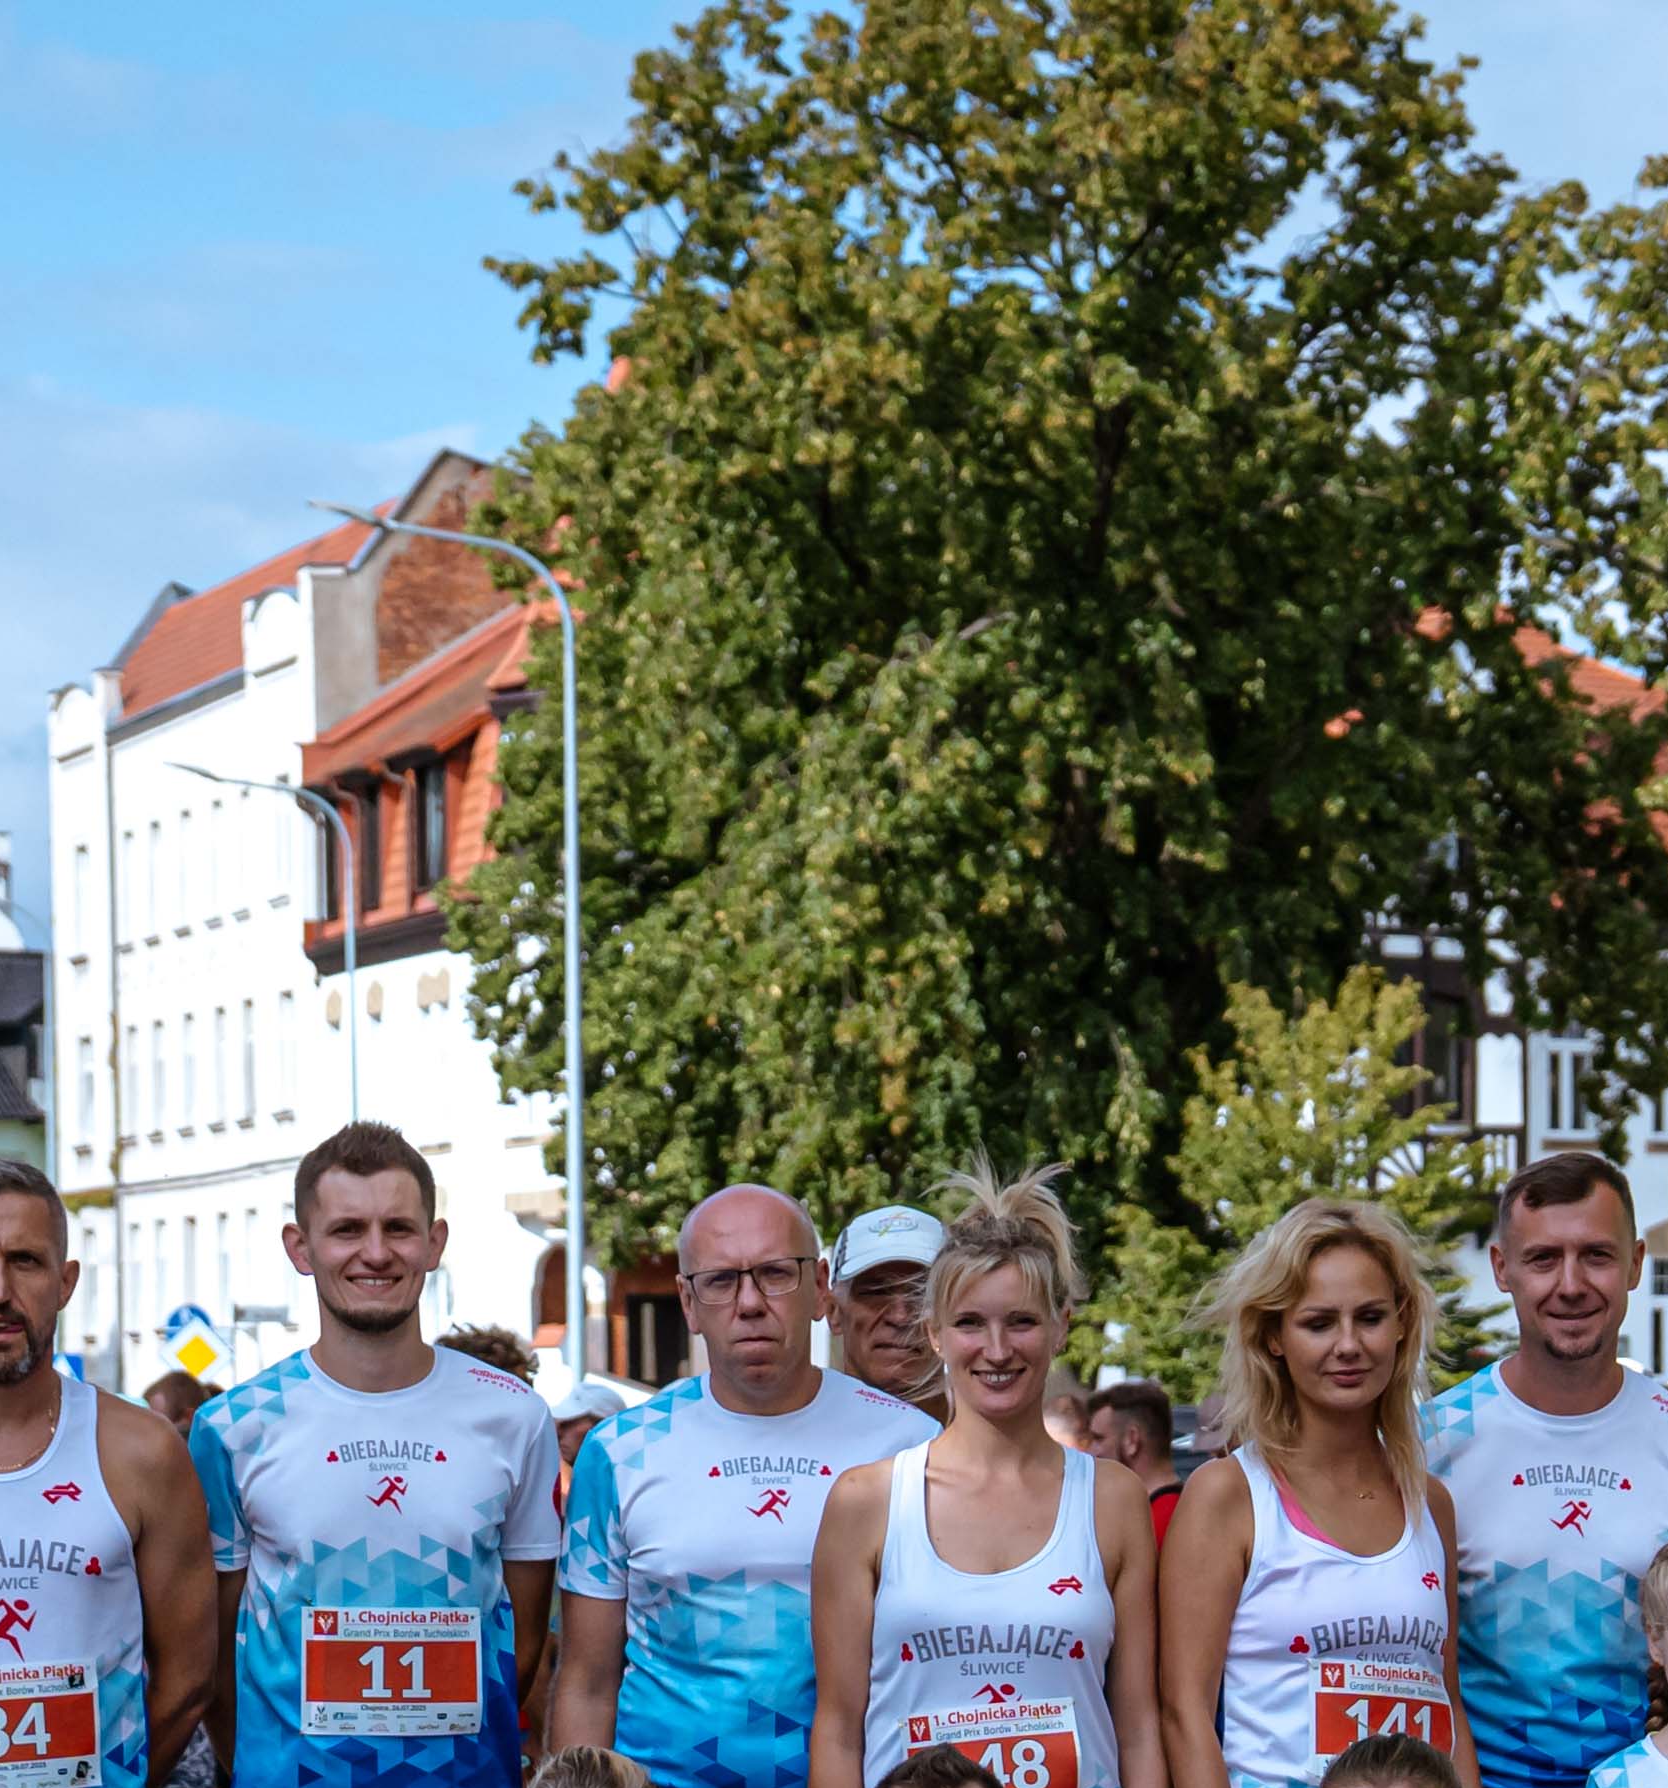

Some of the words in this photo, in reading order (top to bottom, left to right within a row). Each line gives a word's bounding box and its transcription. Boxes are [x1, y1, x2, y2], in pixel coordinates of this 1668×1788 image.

[339, 1439, 434, 1463] BIEGAJĄCE
[722, 1456, 819, 1478] BIEGAJĄCE
[343, 1611, 355, 1623] 1.
[359, 1611, 426, 1626] Chojnicka
[430, 1611, 469, 1626] Piątka
[343, 1629, 371, 1638] Grand
[374, 1629, 390, 1638] Prix
[912, 1623, 1073, 1664] BIEGAJĄCE
[359, 1645, 432, 1698] 11
[960, 1660, 1025, 1676] ŚLIWICE
[1350, 1664, 1361, 1676] 1.
[1364, 1665, 1420, 1681] Chojnicka
[933, 1714, 945, 1727] 1.
[948, 1708, 1016, 1726] Chojnicka
[1019, 1703, 1061, 1720] Piątka
[1345, 1699, 1431, 1745] 141
[936, 1730, 962, 1741] Grand
[964, 1727, 980, 1738] Prix
[984, 1725, 1011, 1736] Borów
